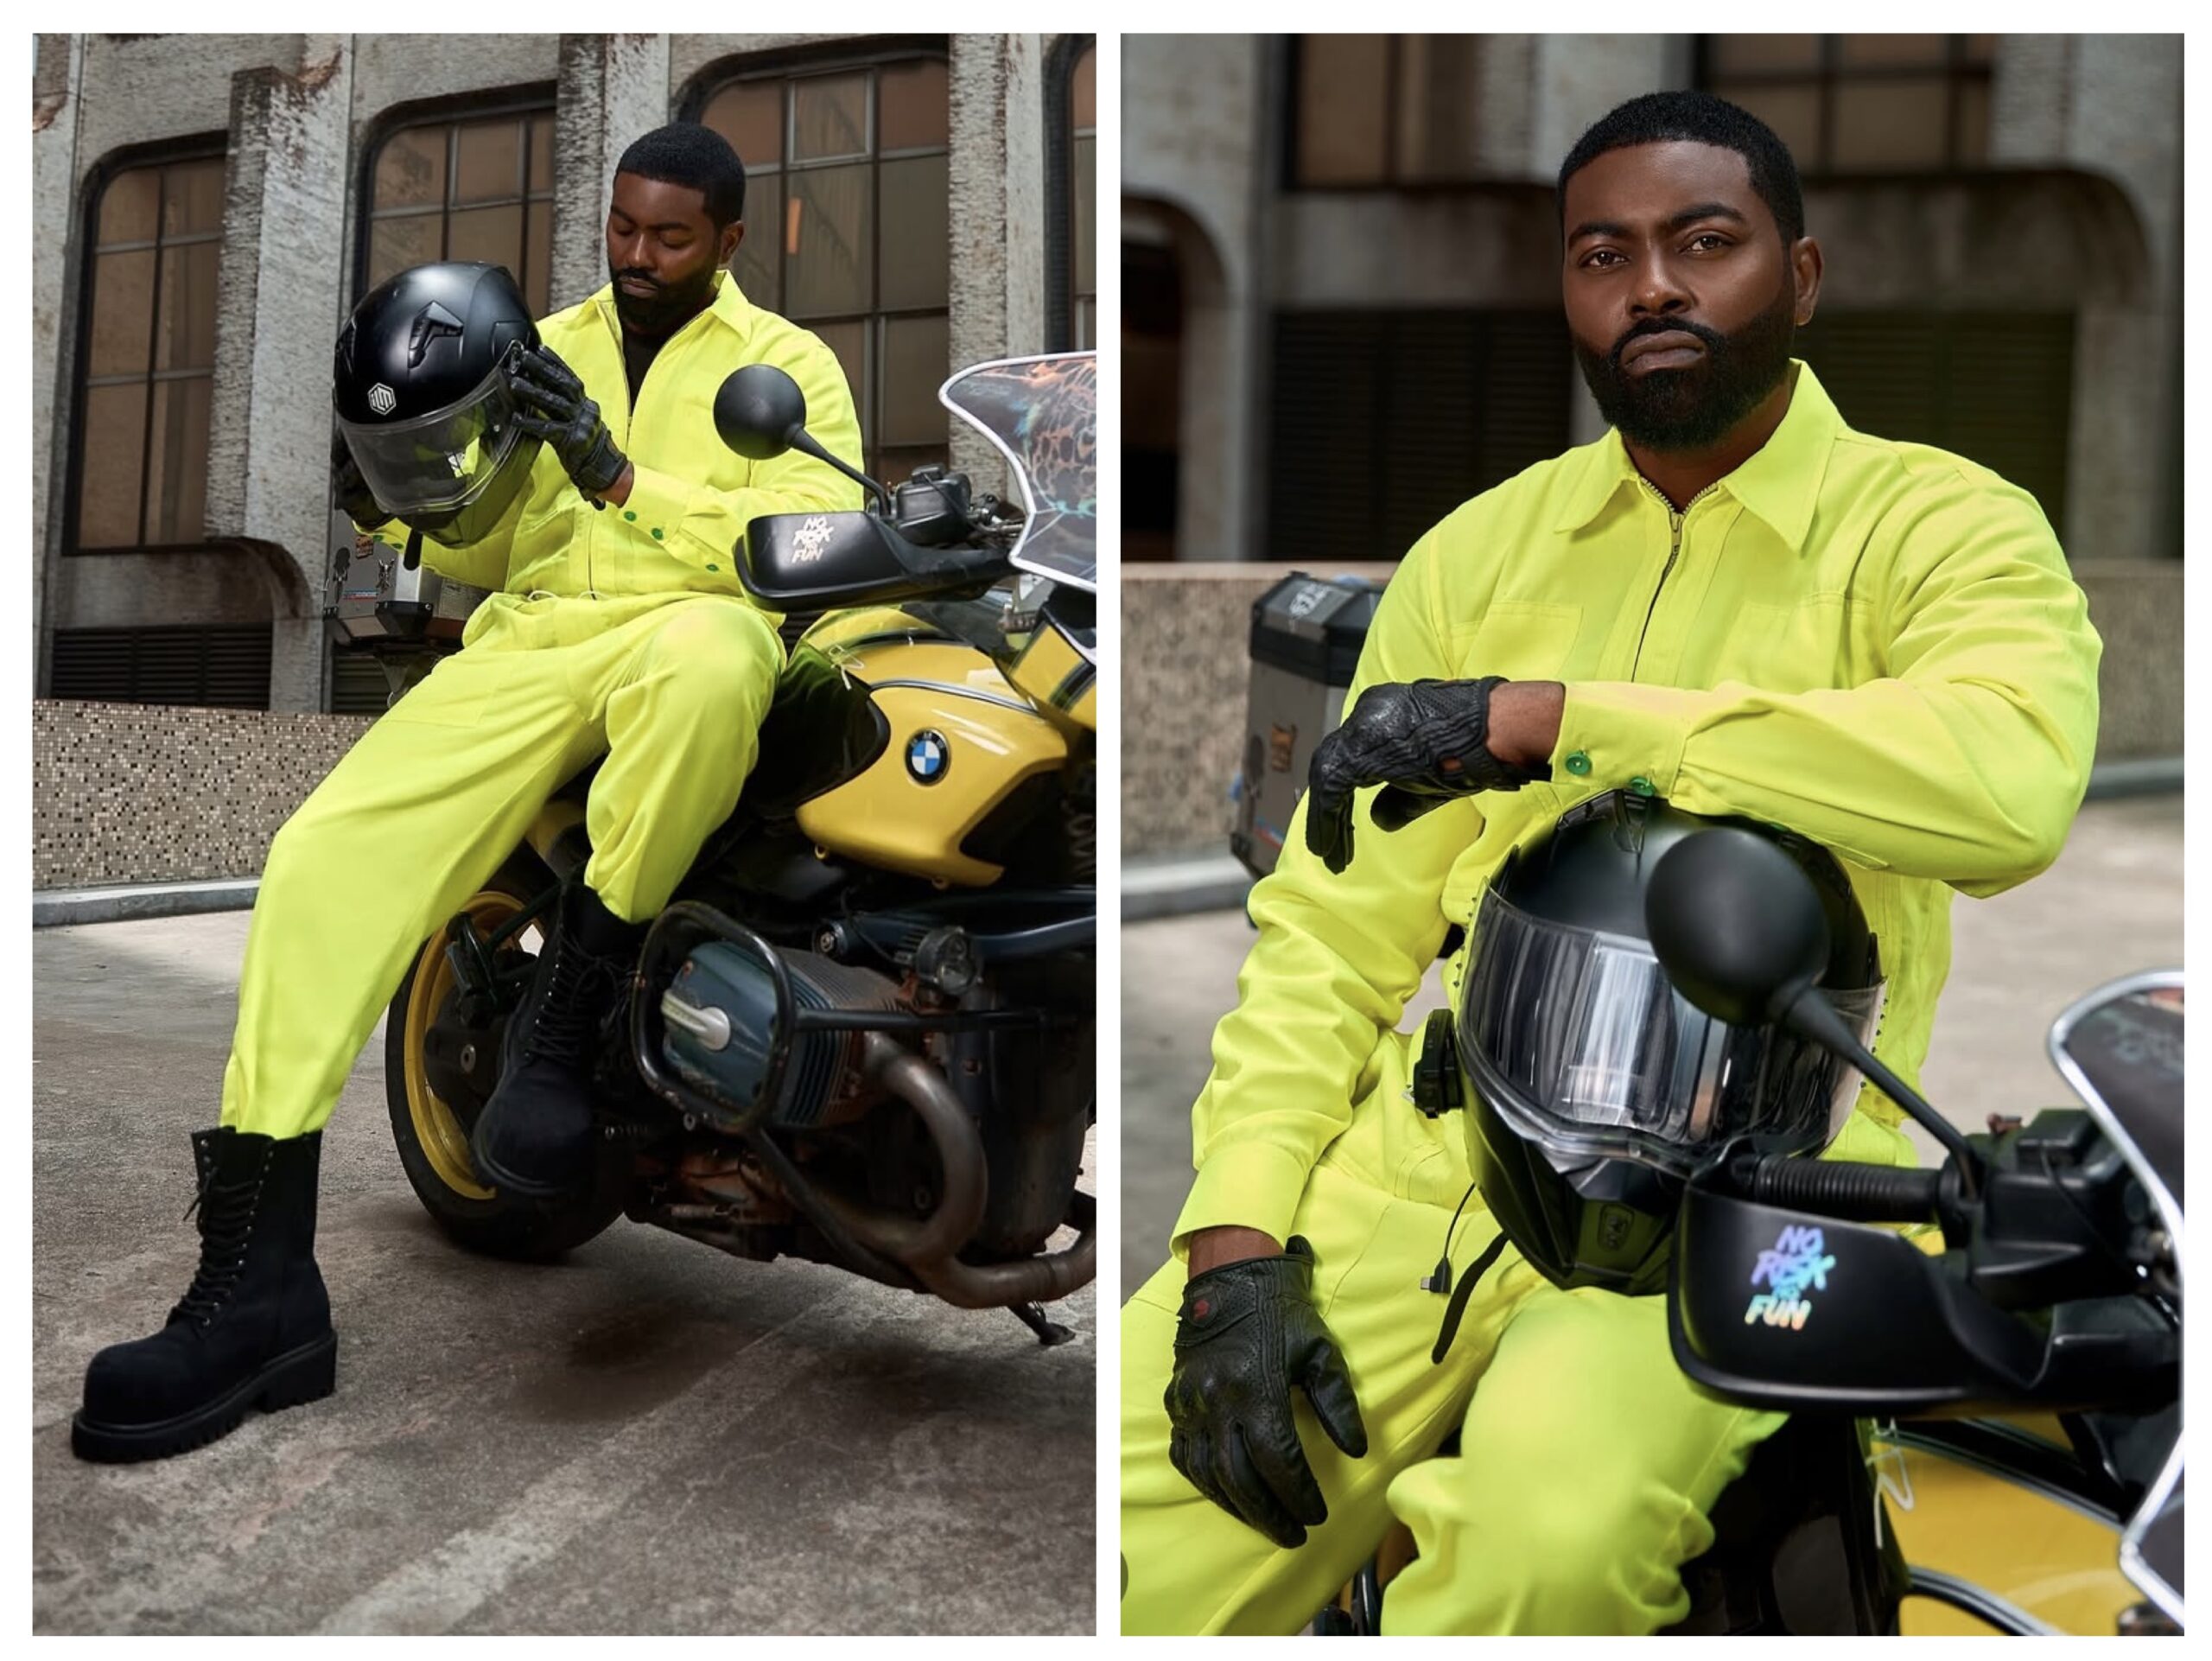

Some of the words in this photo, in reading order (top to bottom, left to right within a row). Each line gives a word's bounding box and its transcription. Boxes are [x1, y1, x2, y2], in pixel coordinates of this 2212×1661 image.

[804, 516, 827, 531] NO
[791, 549, 823, 563] FUN
[1776, 1225, 1824, 1255] NO
[1744, 1295, 1812, 1331] FUN
